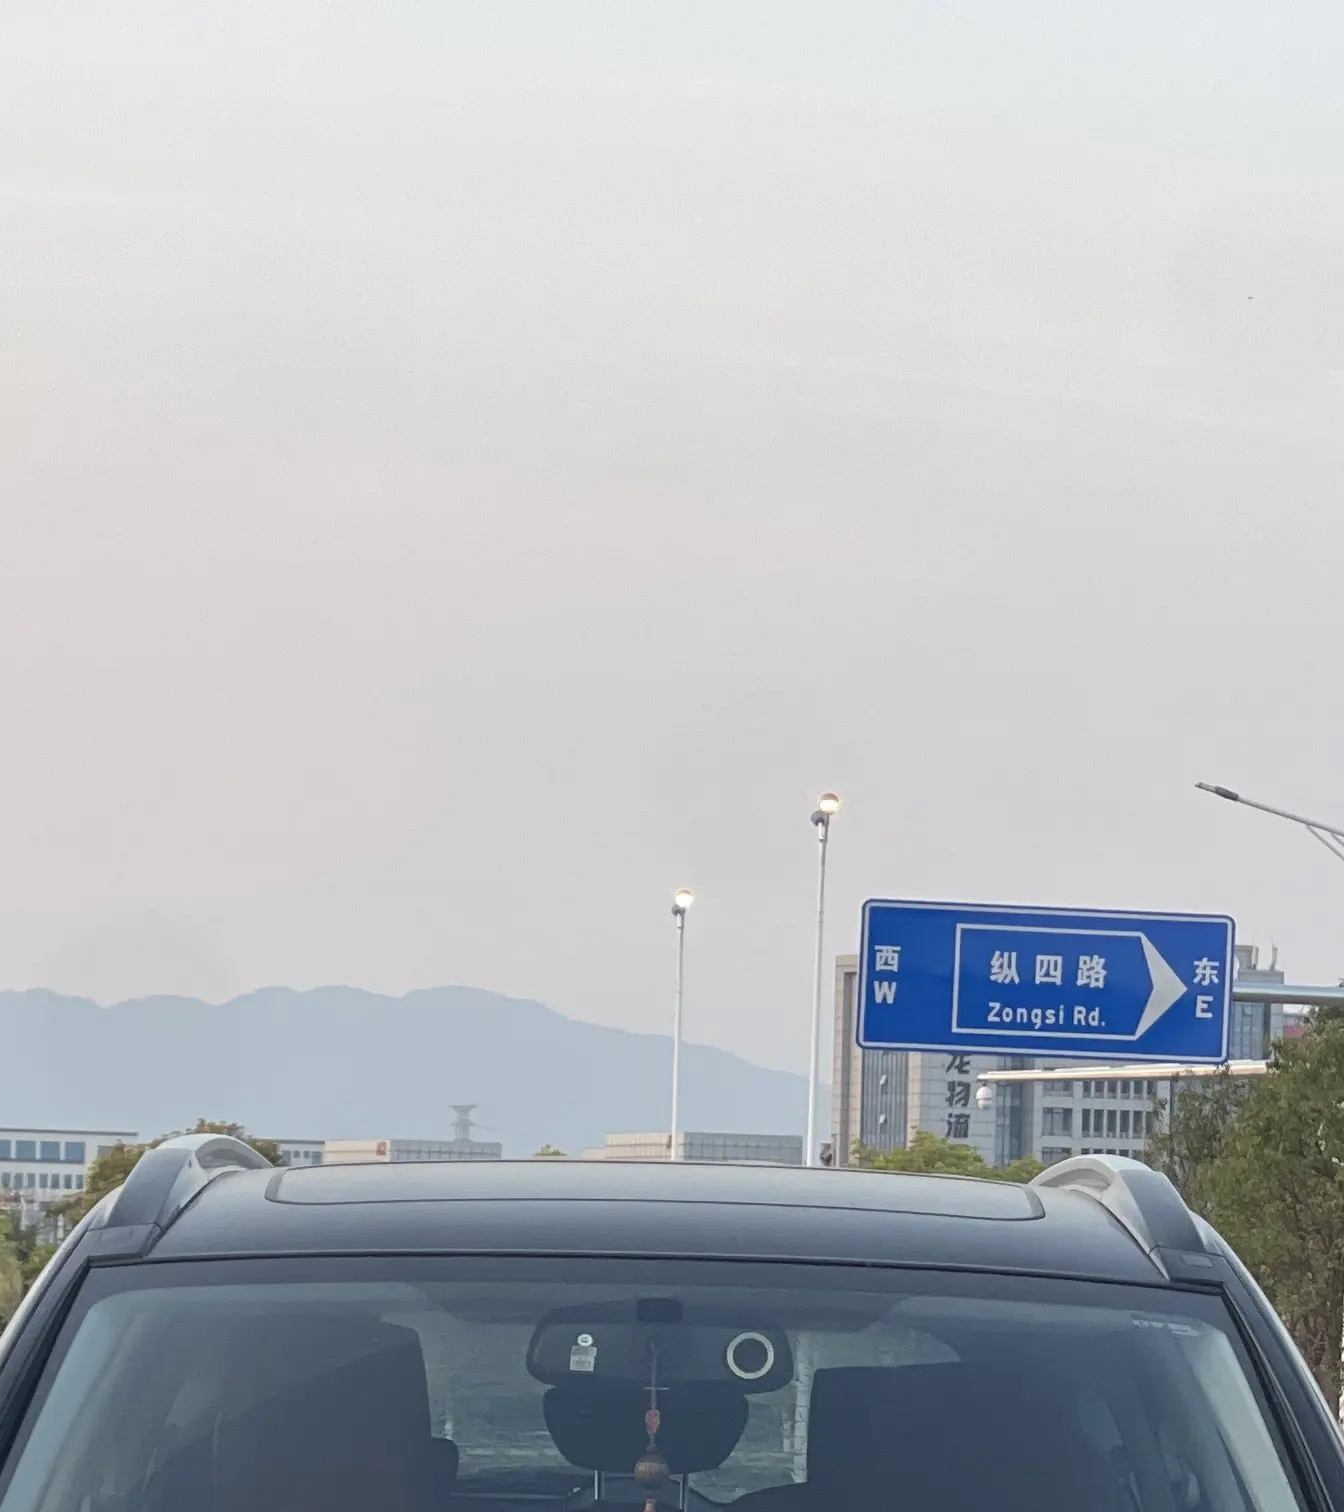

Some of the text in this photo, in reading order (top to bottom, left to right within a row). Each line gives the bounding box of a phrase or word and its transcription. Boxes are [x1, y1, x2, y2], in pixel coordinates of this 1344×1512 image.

[874, 945, 901, 972] 西
[989, 950, 1107, 989] 纵四路
[1192, 957, 1220, 986] 东
[873, 980, 898, 1004] W
[987, 1001, 1106, 1029] Zongsi Rd.
[1196, 995, 1214, 1018] E
